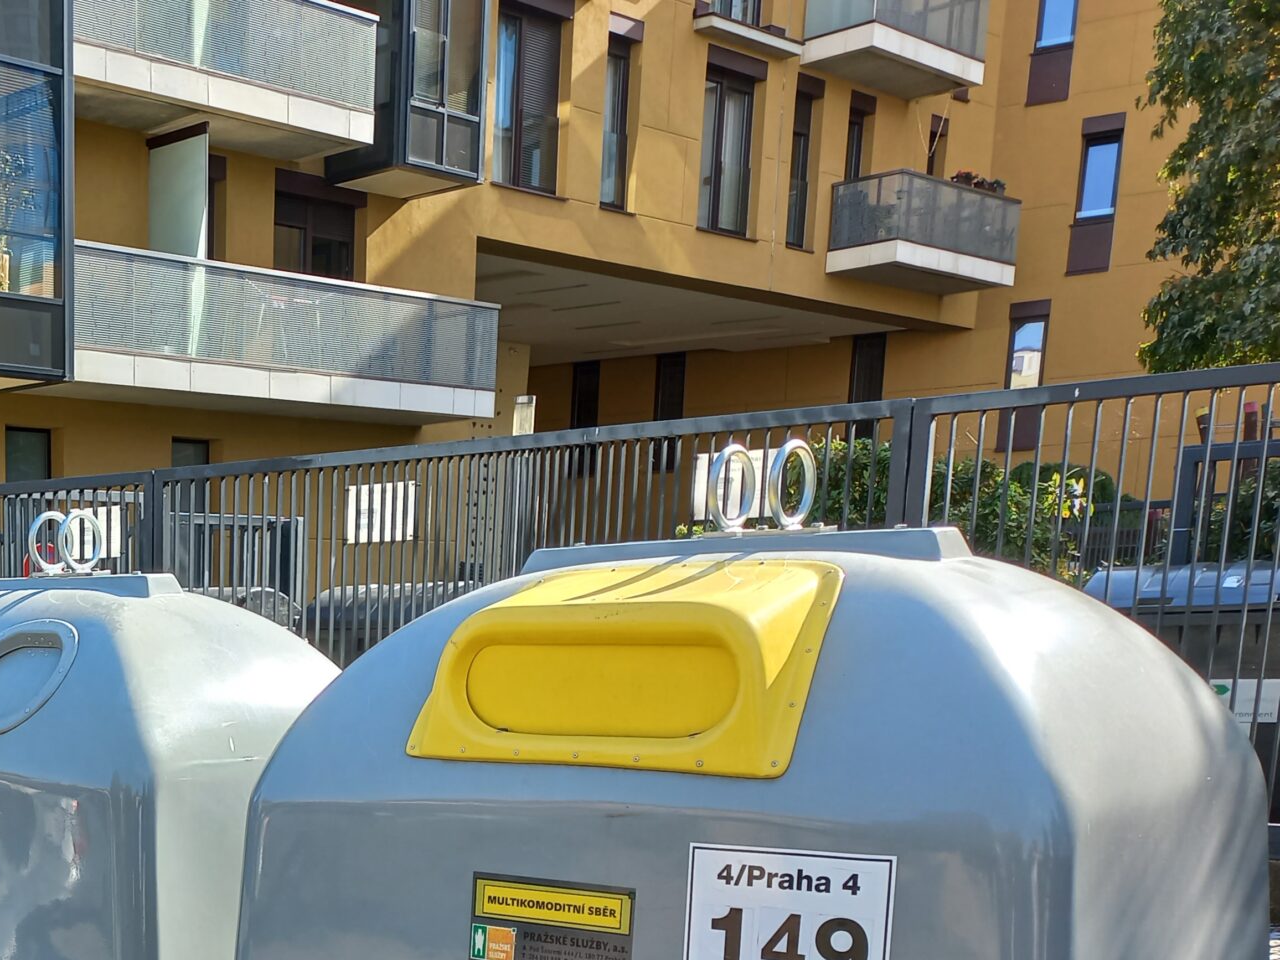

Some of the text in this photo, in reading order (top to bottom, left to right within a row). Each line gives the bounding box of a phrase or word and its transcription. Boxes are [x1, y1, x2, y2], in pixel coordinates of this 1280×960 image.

[716, 864, 861, 896] 4/Praha 4
[487, 895, 616, 918] MULTIKOMODITNÍ SBĚR
[523, 931, 628, 954] PRAŽSKÉ SLUŽBY, a.s.
